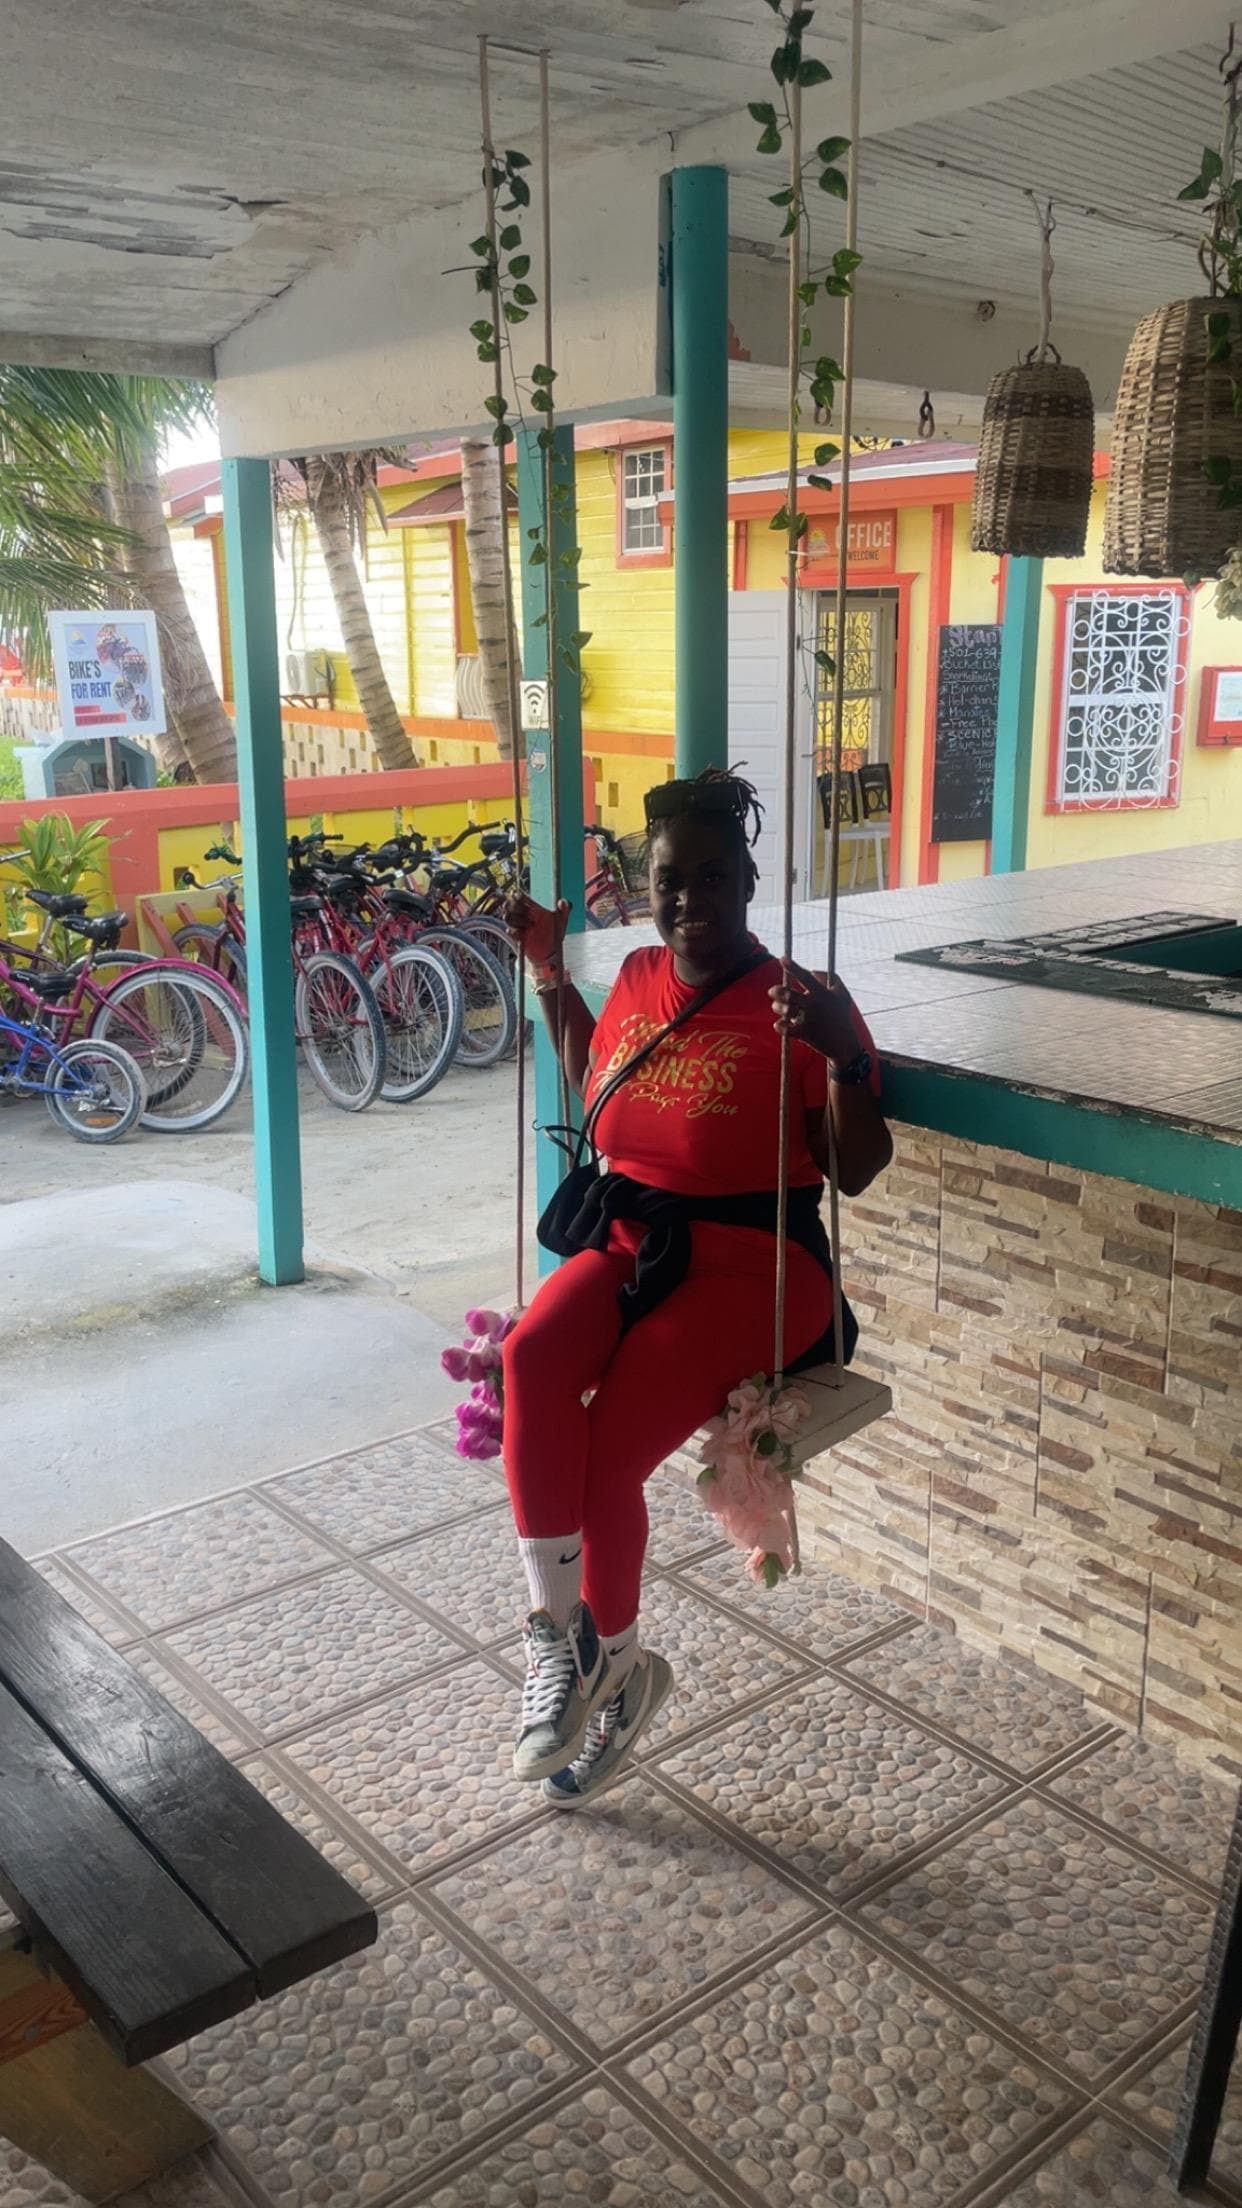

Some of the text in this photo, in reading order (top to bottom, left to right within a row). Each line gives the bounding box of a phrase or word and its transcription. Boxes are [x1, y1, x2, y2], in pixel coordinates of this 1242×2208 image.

[68, 660, 102, 680] BIKE'S
[71, 681, 111, 699] FOR RENT
[699, 1031, 752, 1061] The
[686, 1092, 740, 1119] You
